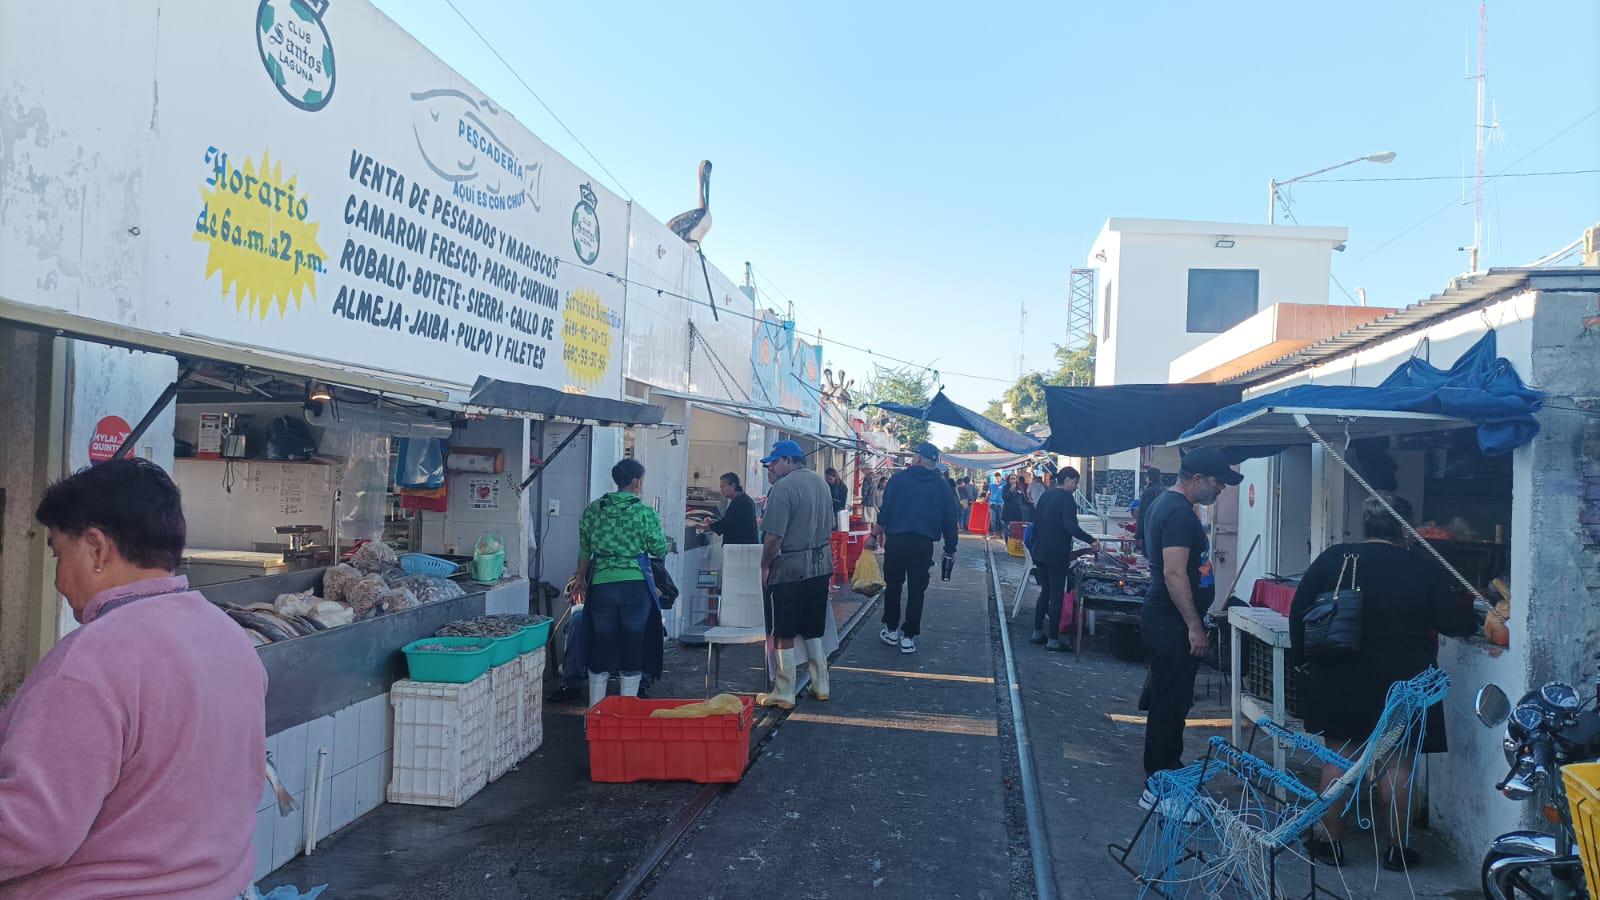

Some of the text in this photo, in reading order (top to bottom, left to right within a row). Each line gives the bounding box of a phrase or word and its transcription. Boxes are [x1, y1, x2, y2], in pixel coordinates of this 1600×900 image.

[269, 22, 322, 74] Santos
[279, 50, 314, 83] LAGUNA
[288, 20, 312, 44] CLUB
[205, 145, 308, 221] Horario
[349, 149, 559, 280] VENTA DE PESCADOS Y MARISCOS
[477, 190, 487, 207] ES
[489, 195, 505, 210] CON
[507, 189, 525, 210] CHUY
[340, 238, 554, 341] ROBALO BOTETE SIERRA CALLO DE
[344, 194, 559, 312] CAMARON FRESCO PARGO CURVINA
[332, 284, 546, 370] ALMEJA JAIBA PULPO Y FILETES
